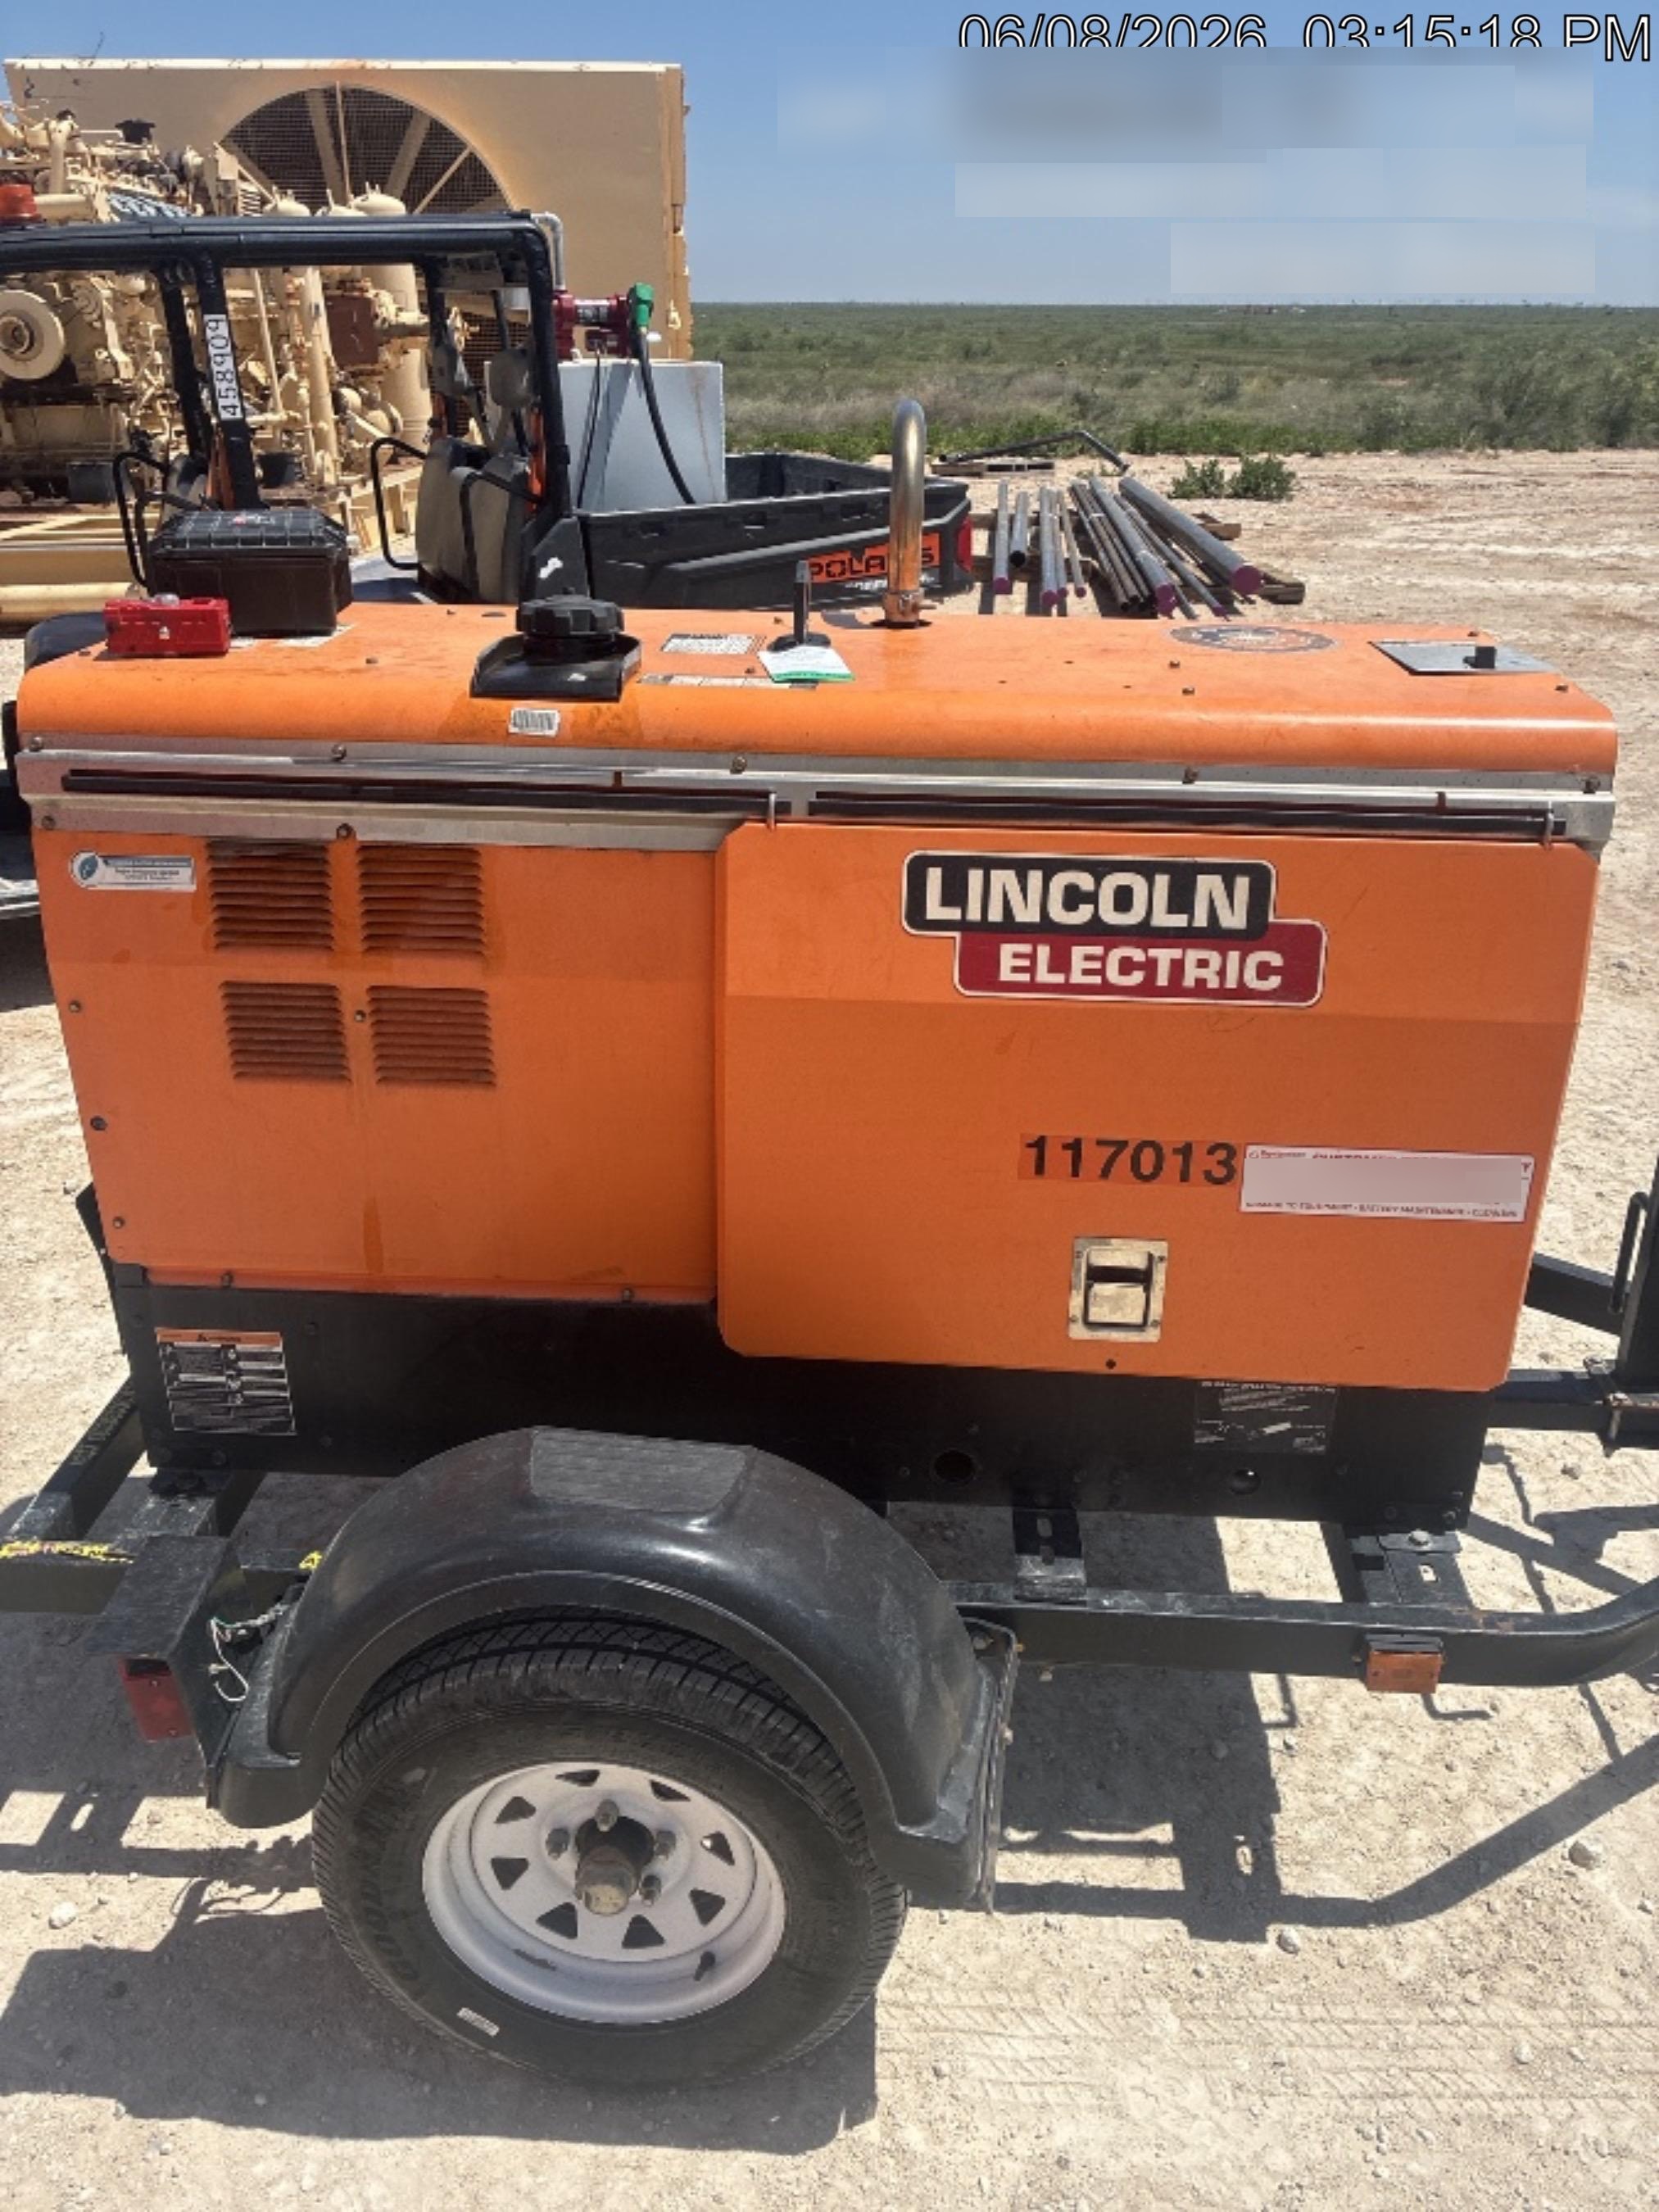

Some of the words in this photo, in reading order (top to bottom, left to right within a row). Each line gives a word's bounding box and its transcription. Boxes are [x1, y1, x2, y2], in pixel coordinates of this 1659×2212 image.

[809, 546, 935, 581] POLAS
[926, 867, 1249, 930] LINCOLN
[999, 943, 1284, 990] ELECTRIC
[1026, 1135, 1238, 1185] 117013
